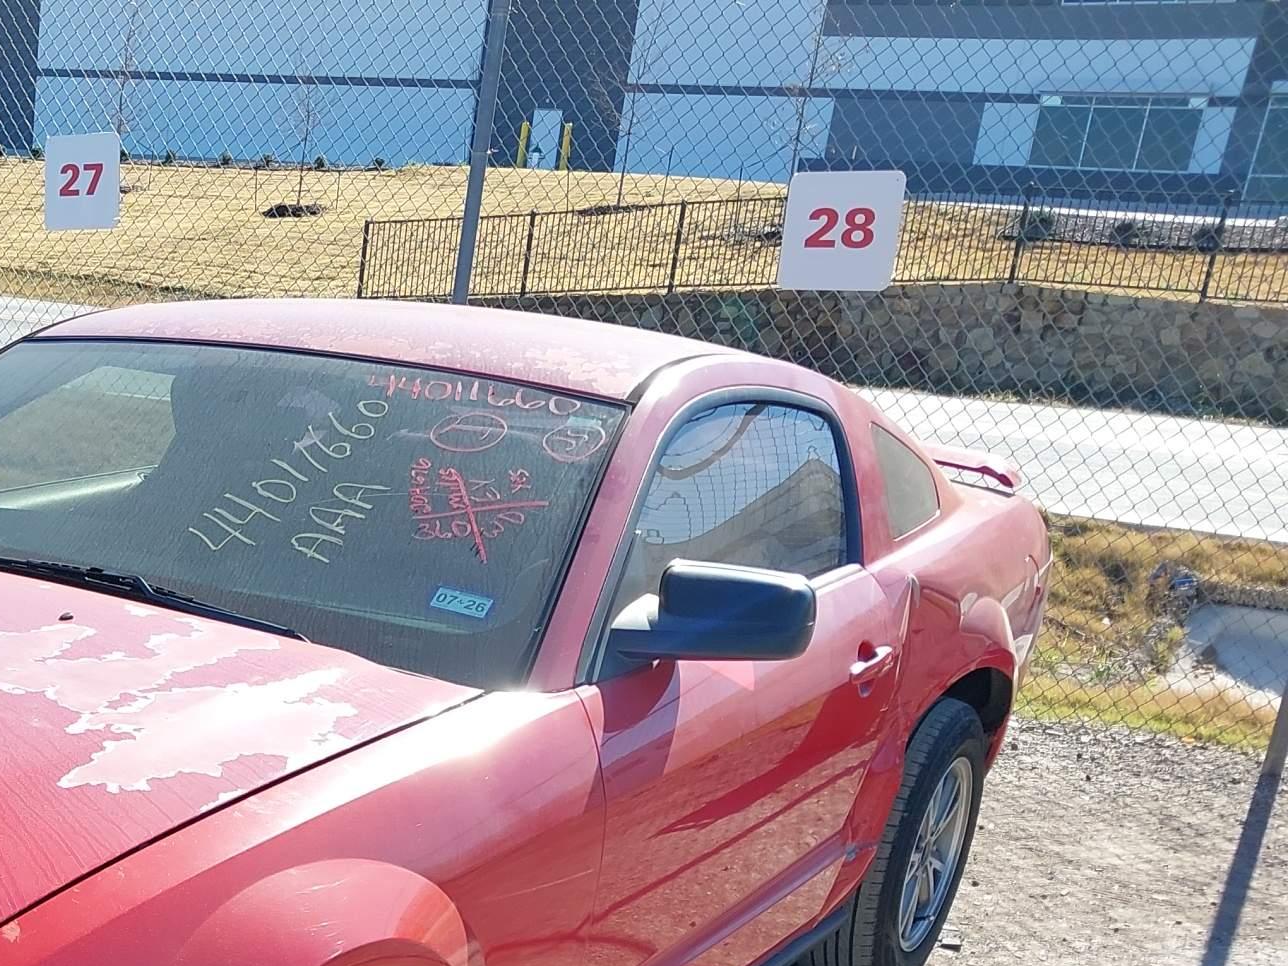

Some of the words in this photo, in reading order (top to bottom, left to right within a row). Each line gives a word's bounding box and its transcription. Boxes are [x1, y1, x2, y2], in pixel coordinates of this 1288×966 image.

[59, 163, 104, 197] 27
[803, 207, 876, 249] 28
[290, 482, 392, 564] AAA
